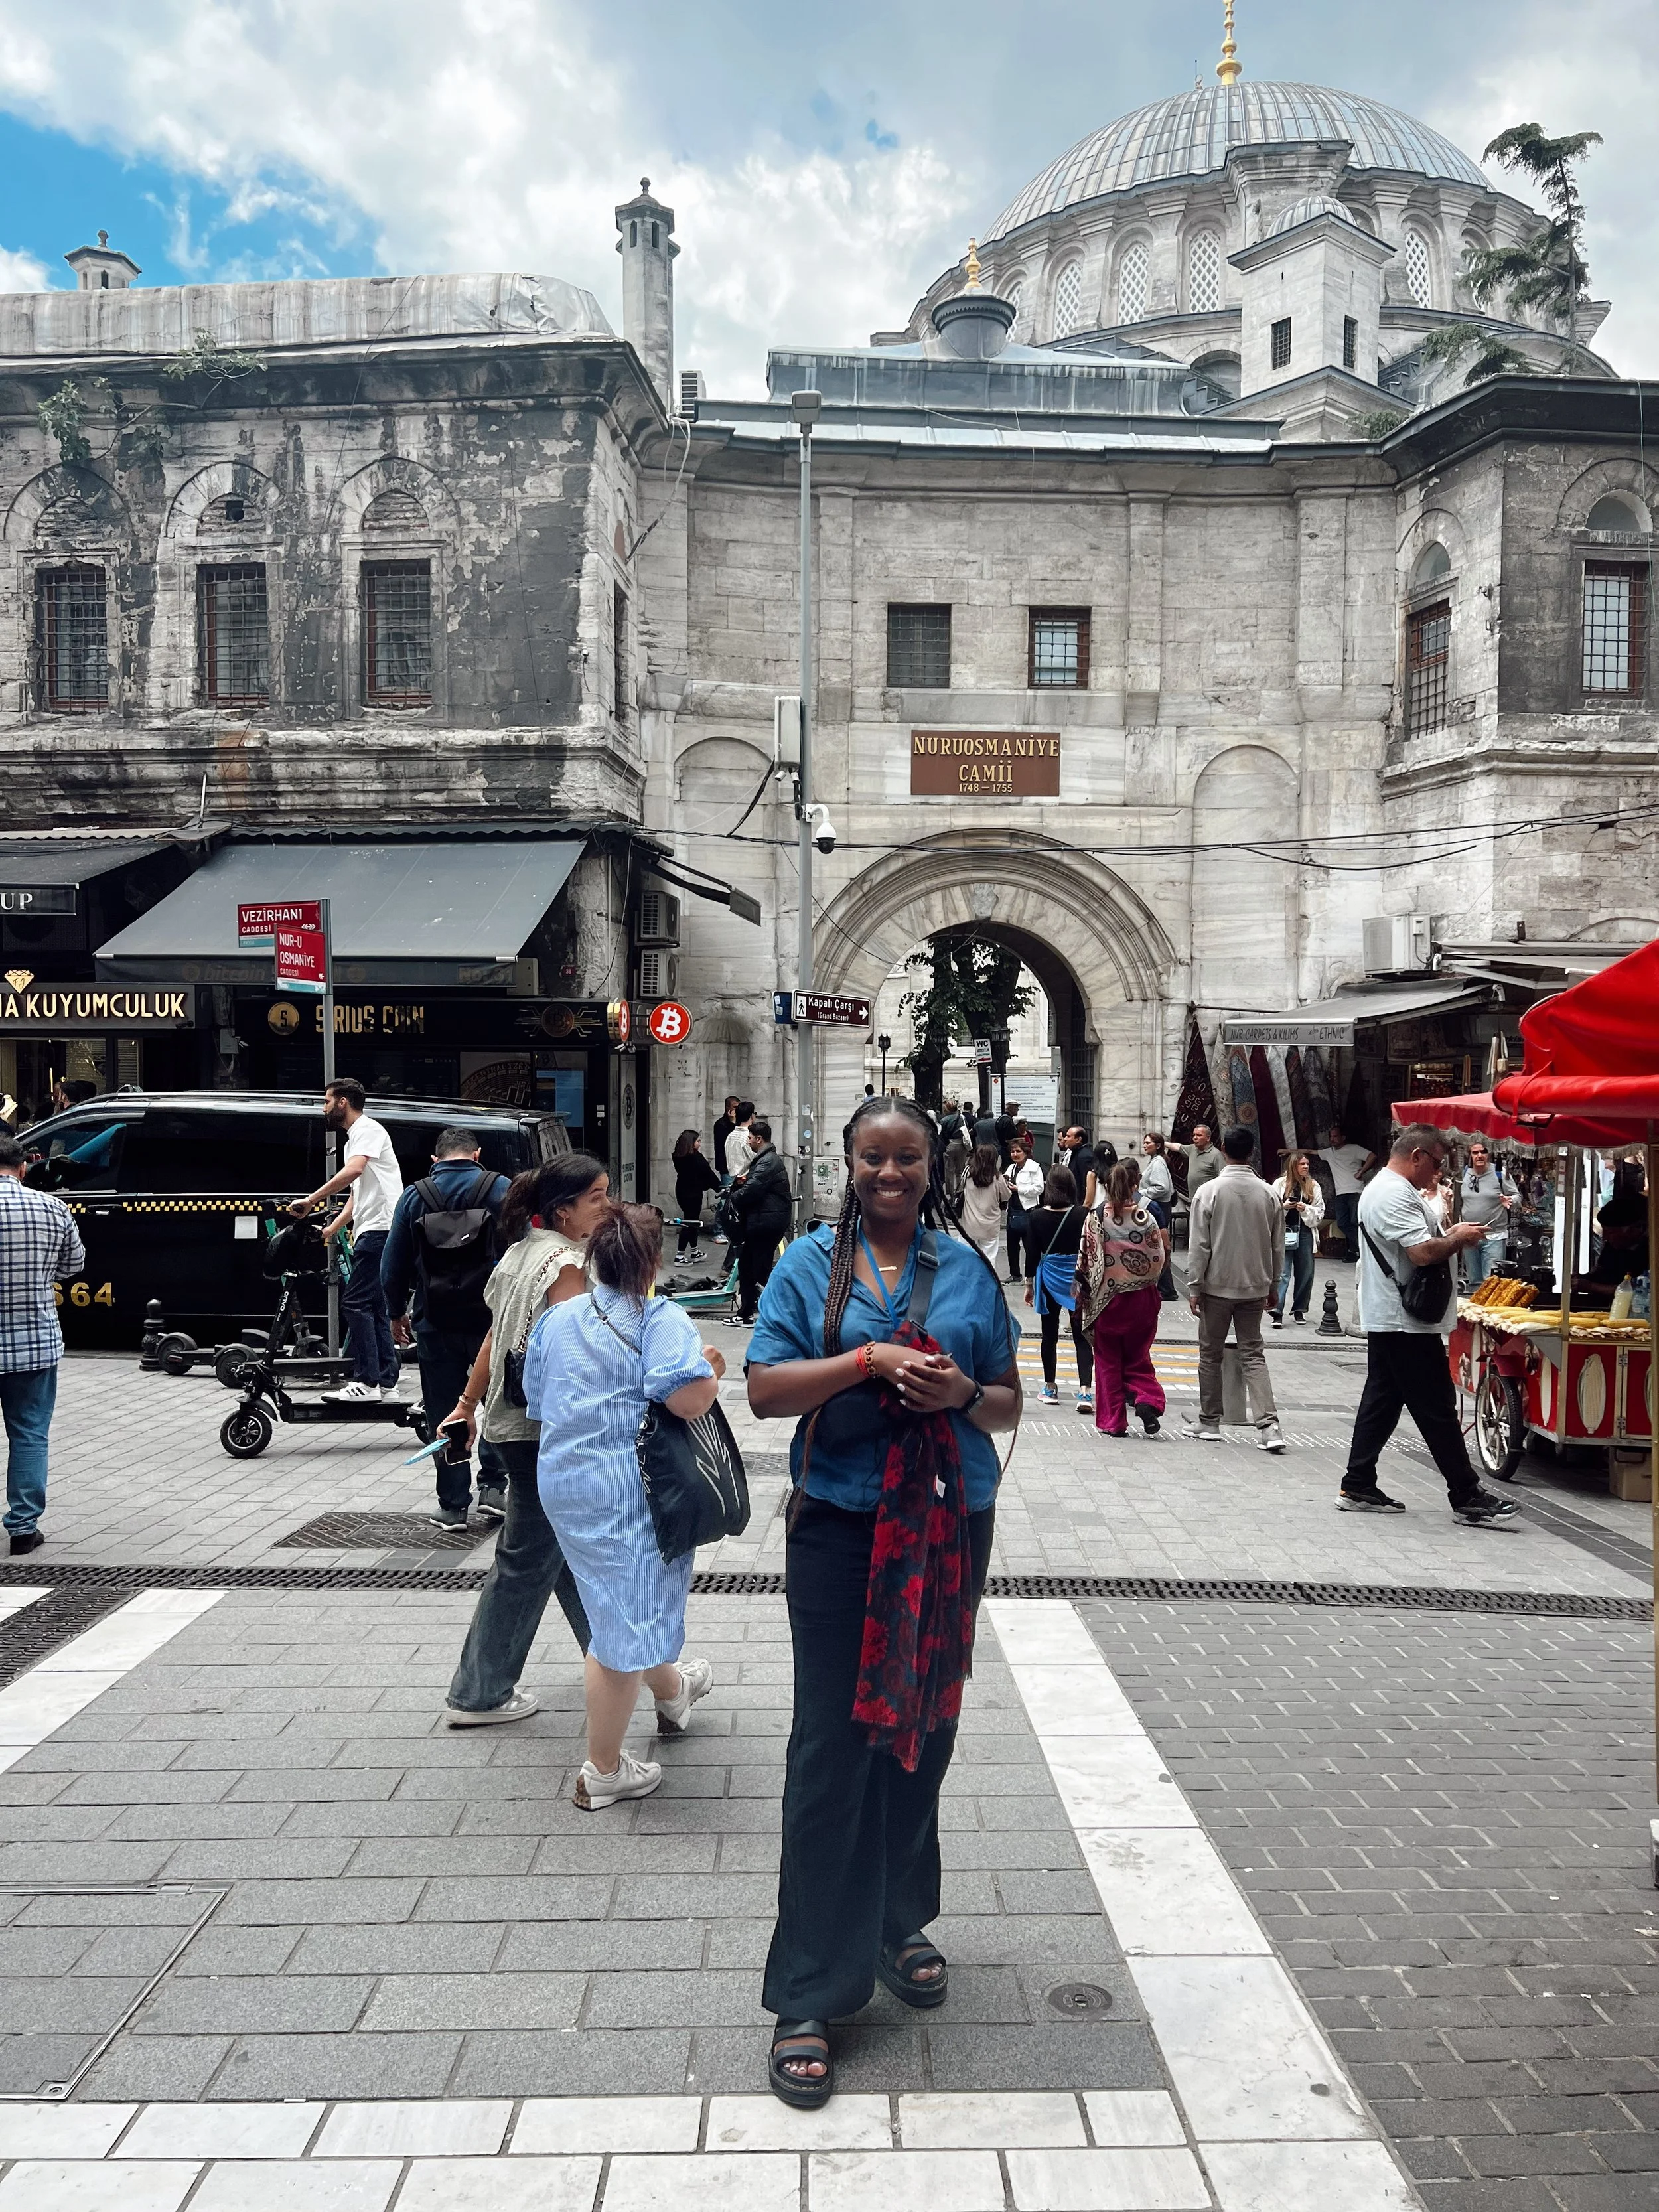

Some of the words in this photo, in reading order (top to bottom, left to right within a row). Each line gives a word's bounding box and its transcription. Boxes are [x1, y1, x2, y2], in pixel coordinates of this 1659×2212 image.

[913, 734, 1059, 757] NURUOSMANİYE
[958, 760, 1013, 782] CAMİİ
[958, 784, 979, 793] 1748
[992, 784, 1013, 793] 1755
[279, 932, 303, 948] NUR-U
[279, 951, 315, 968] OSMANİYE
[26, 993, 186, 1018] KUYUMCULUK
[808, 996, 833, 1009] Kapalı
[835, 999, 855, 1012] Çarşı
[315, 1005, 374, 1033] SRIUS
[817, 1011, 832, 1020] (Grand
[1245, 1028, 1272, 1040] CARPETS
[1278, 1027, 1299, 1040] KILIMS
[1319, 1027, 1344, 1039] ETHNIC
